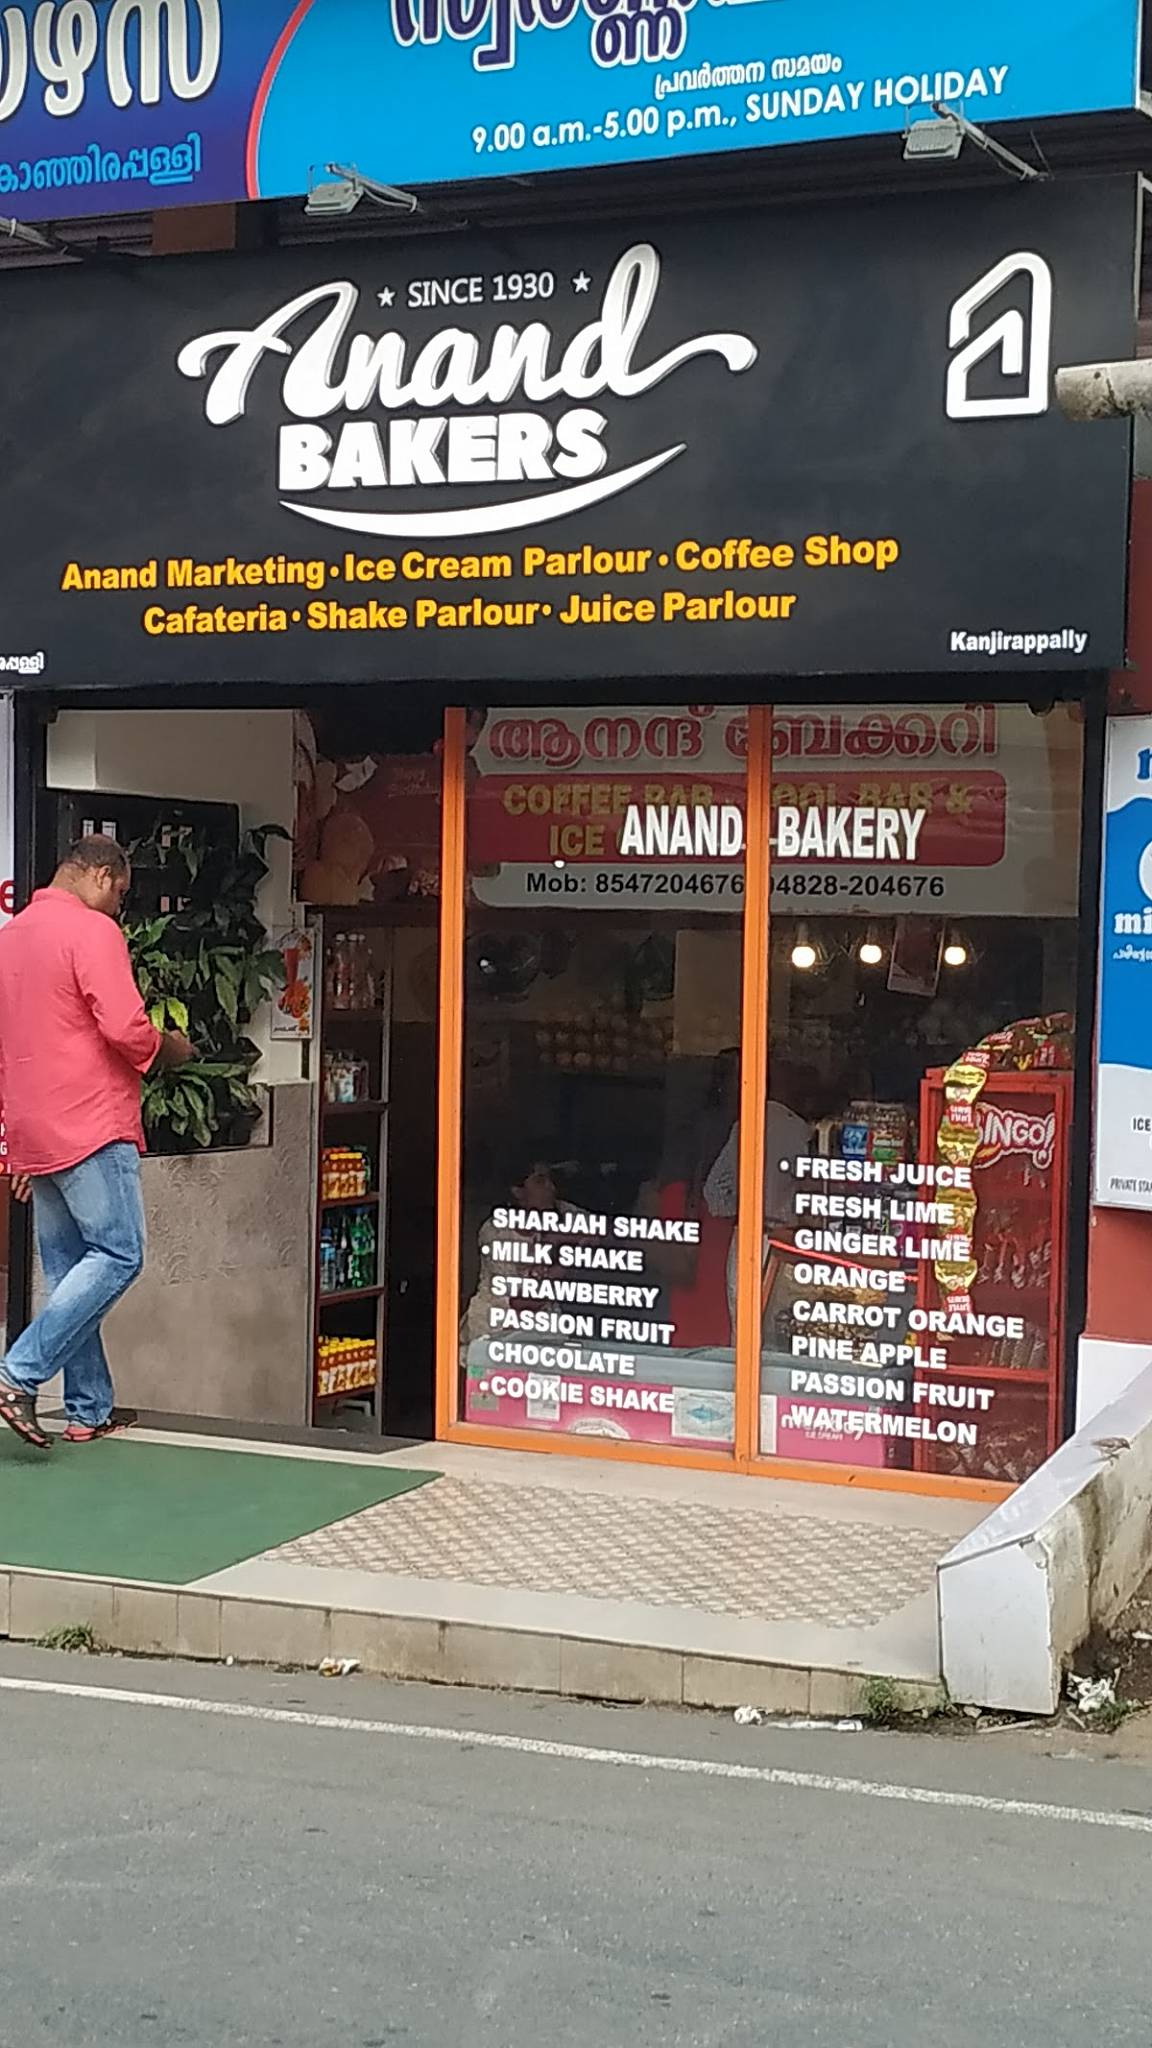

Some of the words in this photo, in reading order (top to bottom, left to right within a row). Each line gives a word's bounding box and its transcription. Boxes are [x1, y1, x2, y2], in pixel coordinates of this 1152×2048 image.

[771, 54, 842, 79] സമയം
[472, 122, 525, 152] 9.00
[667, 105, 736, 137] p.m.,
[745, 77, 863, 122] SUNDAY
[874, 66, 1007, 107] HOLIDAY
[408, 277, 483, 308] SINCE
[493, 272, 554, 301] 1930
[176, 242, 759, 426] Anand
[278, 407, 609, 492] BAKERS
[62, 560, 157, 590] Anand
[167, 556, 325, 590] Marketing
[345, 554, 396, 581] Ice
[402, 551, 512, 579] Cream
[524, 545, 652, 576] Parlour
[676, 539, 794, 570] Coffee
[804, 535, 898, 570] Shop
[144, 604, 287, 634] Cafateria
[307, 600, 407, 629] Shake
[416, 598, 540, 627] Parlour
[559, 594, 656, 624] Juice
[663, 590, 796, 621] Parlour
[951, 629, 1087, 655] Kanjirappally
[503, 784, 632, 816] COFFEE
[550, 825, 604, 856] ICE
[620, 805, 743, 856] ANAND
[526, 871, 587, 894] Mob:
[596, 873, 744, 894] 8547204676
[770, 874, 944, 897] 4828-204676
[978, 1110, 1056, 1162] INGO!
[1132, 1117, 1152, 1132] ICE
[796, 1156, 883, 1183] FRESH
[889, 1163, 972, 1189] JUICE
[492, 1208, 607, 1236] SHARJAH
[613, 1216, 700, 1243] SHAKE
[795, 1193, 882, 1220] FRESH
[890, 1199, 955, 1225] LIME
[492, 1240, 553, 1265] MILK
[558, 1245, 643, 1271] SHAKE
[794, 1229, 898, 1257] GINGER
[905, 1234, 972, 1262] LIME
[491, 1275, 659, 1308] STRAWBERRY
[792, 1264, 906, 1293] ORANGE
[489, 1307, 594, 1337] PASSION
[600, 1318, 675, 1345] FRUIT
[793, 1300, 902, 1328] CARROT
[907, 1303, 1024, 1340] ORANGE
[488, 1341, 636, 1376] CHOCOLATE
[792, 1335, 854, 1364] PINE
[856, 1342, 947, 1370] APPLE
[490, 1376, 584, 1404] COOKIE
[590, 1385, 675, 1413] SHAKE
[790, 1369, 904, 1402] PASSION
[912, 1381, 995, 1410] FRUIT
[788, 1404, 978, 1447] WATERMELON
